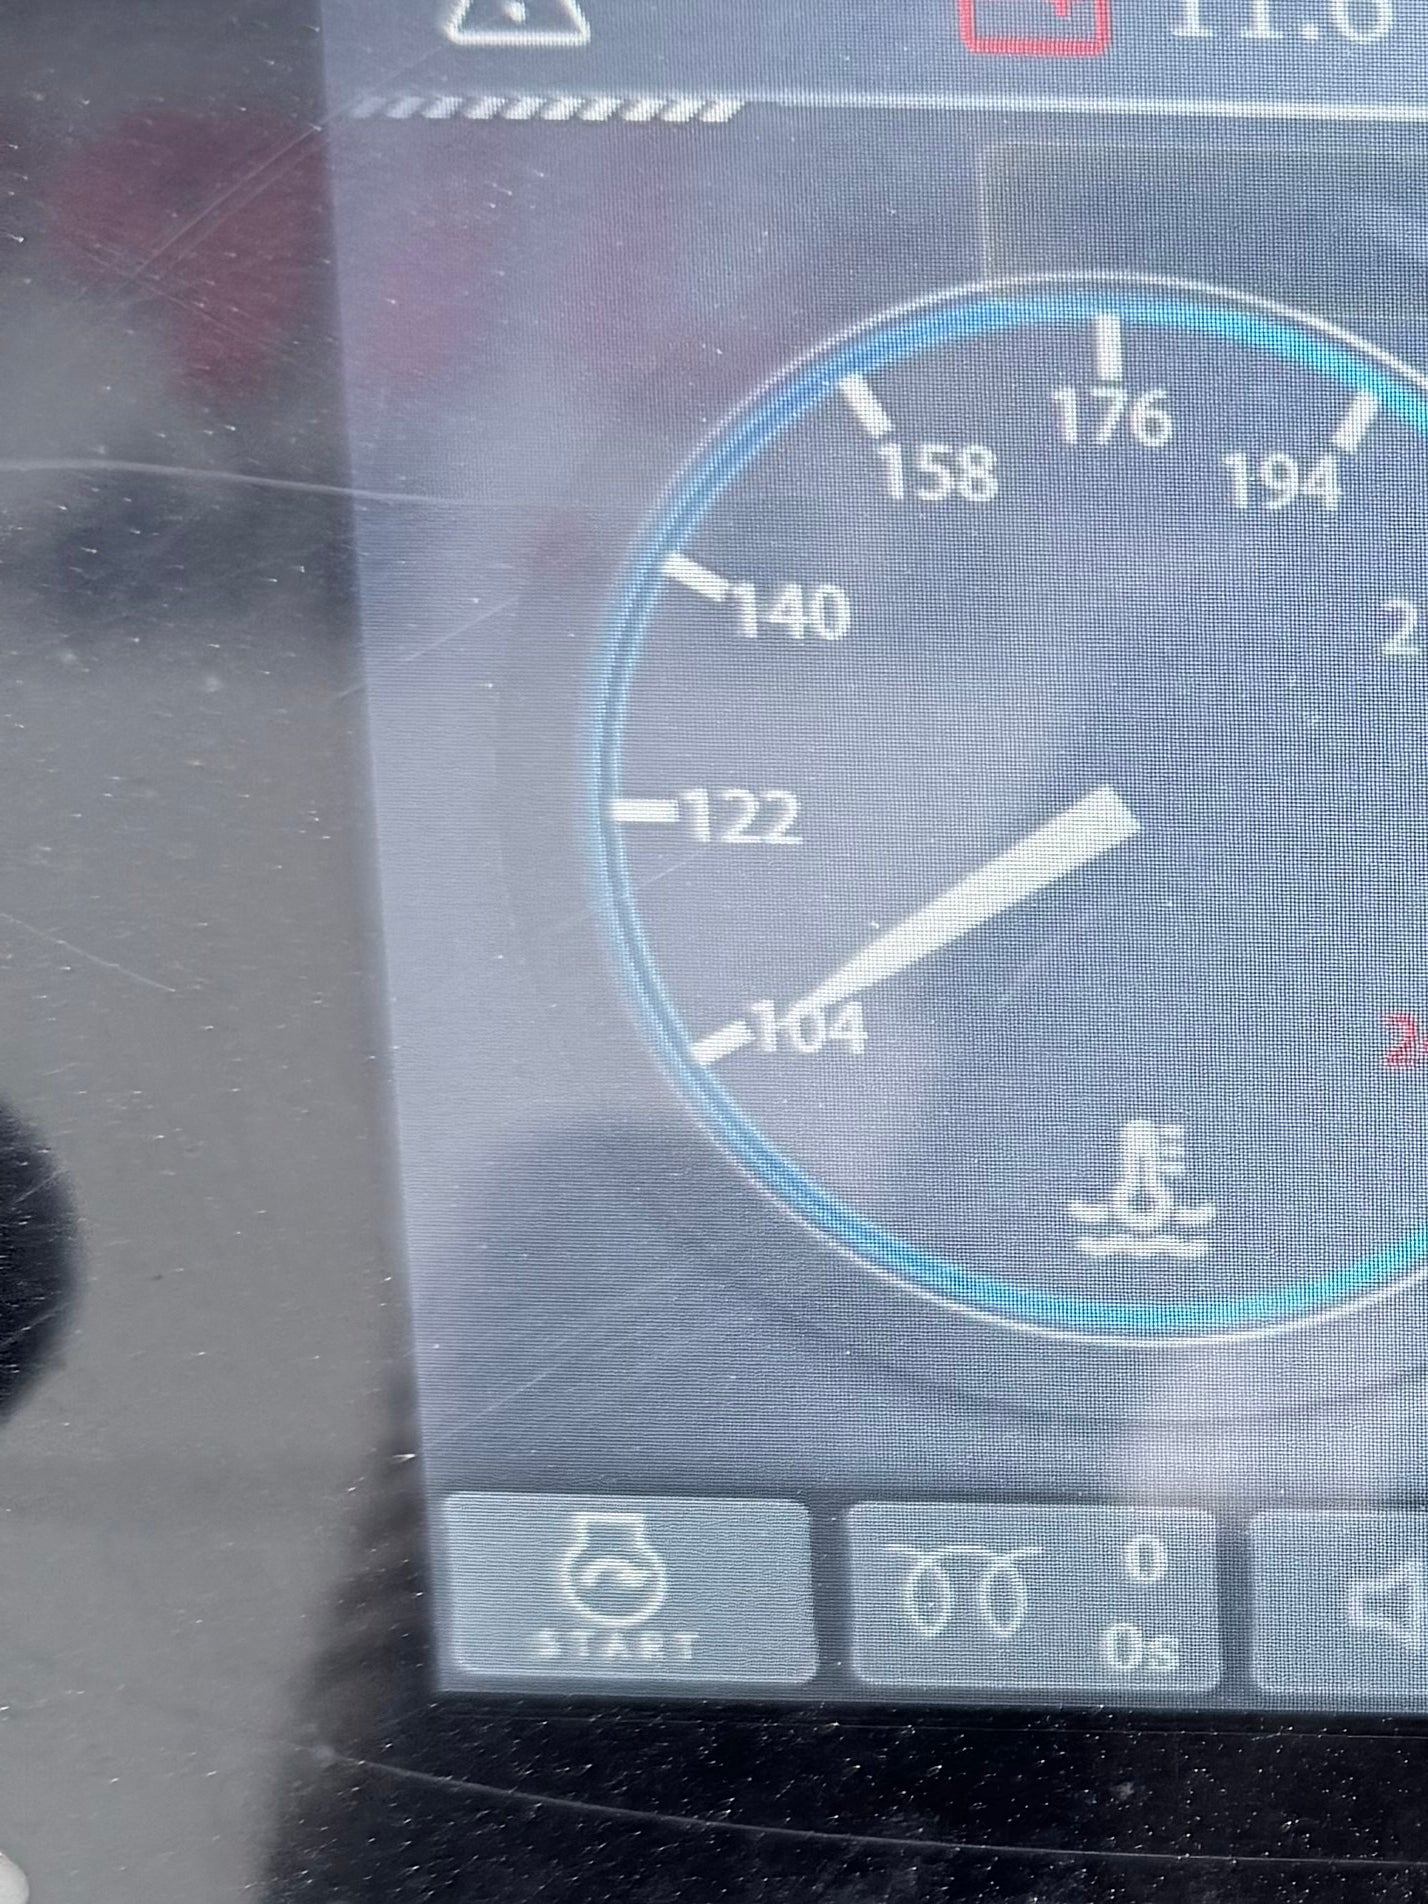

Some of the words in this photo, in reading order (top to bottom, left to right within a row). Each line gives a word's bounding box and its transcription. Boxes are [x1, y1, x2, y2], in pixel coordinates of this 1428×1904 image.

[1052, 388, 1175, 446] 176
[879, 444, 999, 502] 158
[1224, 453, 1342, 510] 194
[730, 588, 850, 643] 140
[680, 789, 802, 845] 122
[749, 1000, 867, 1055] 104
[1124, 1533, 1166, 1581] 0
[536, 1629, 699, 1661] START
[1099, 1621, 1180, 1676] 0s
